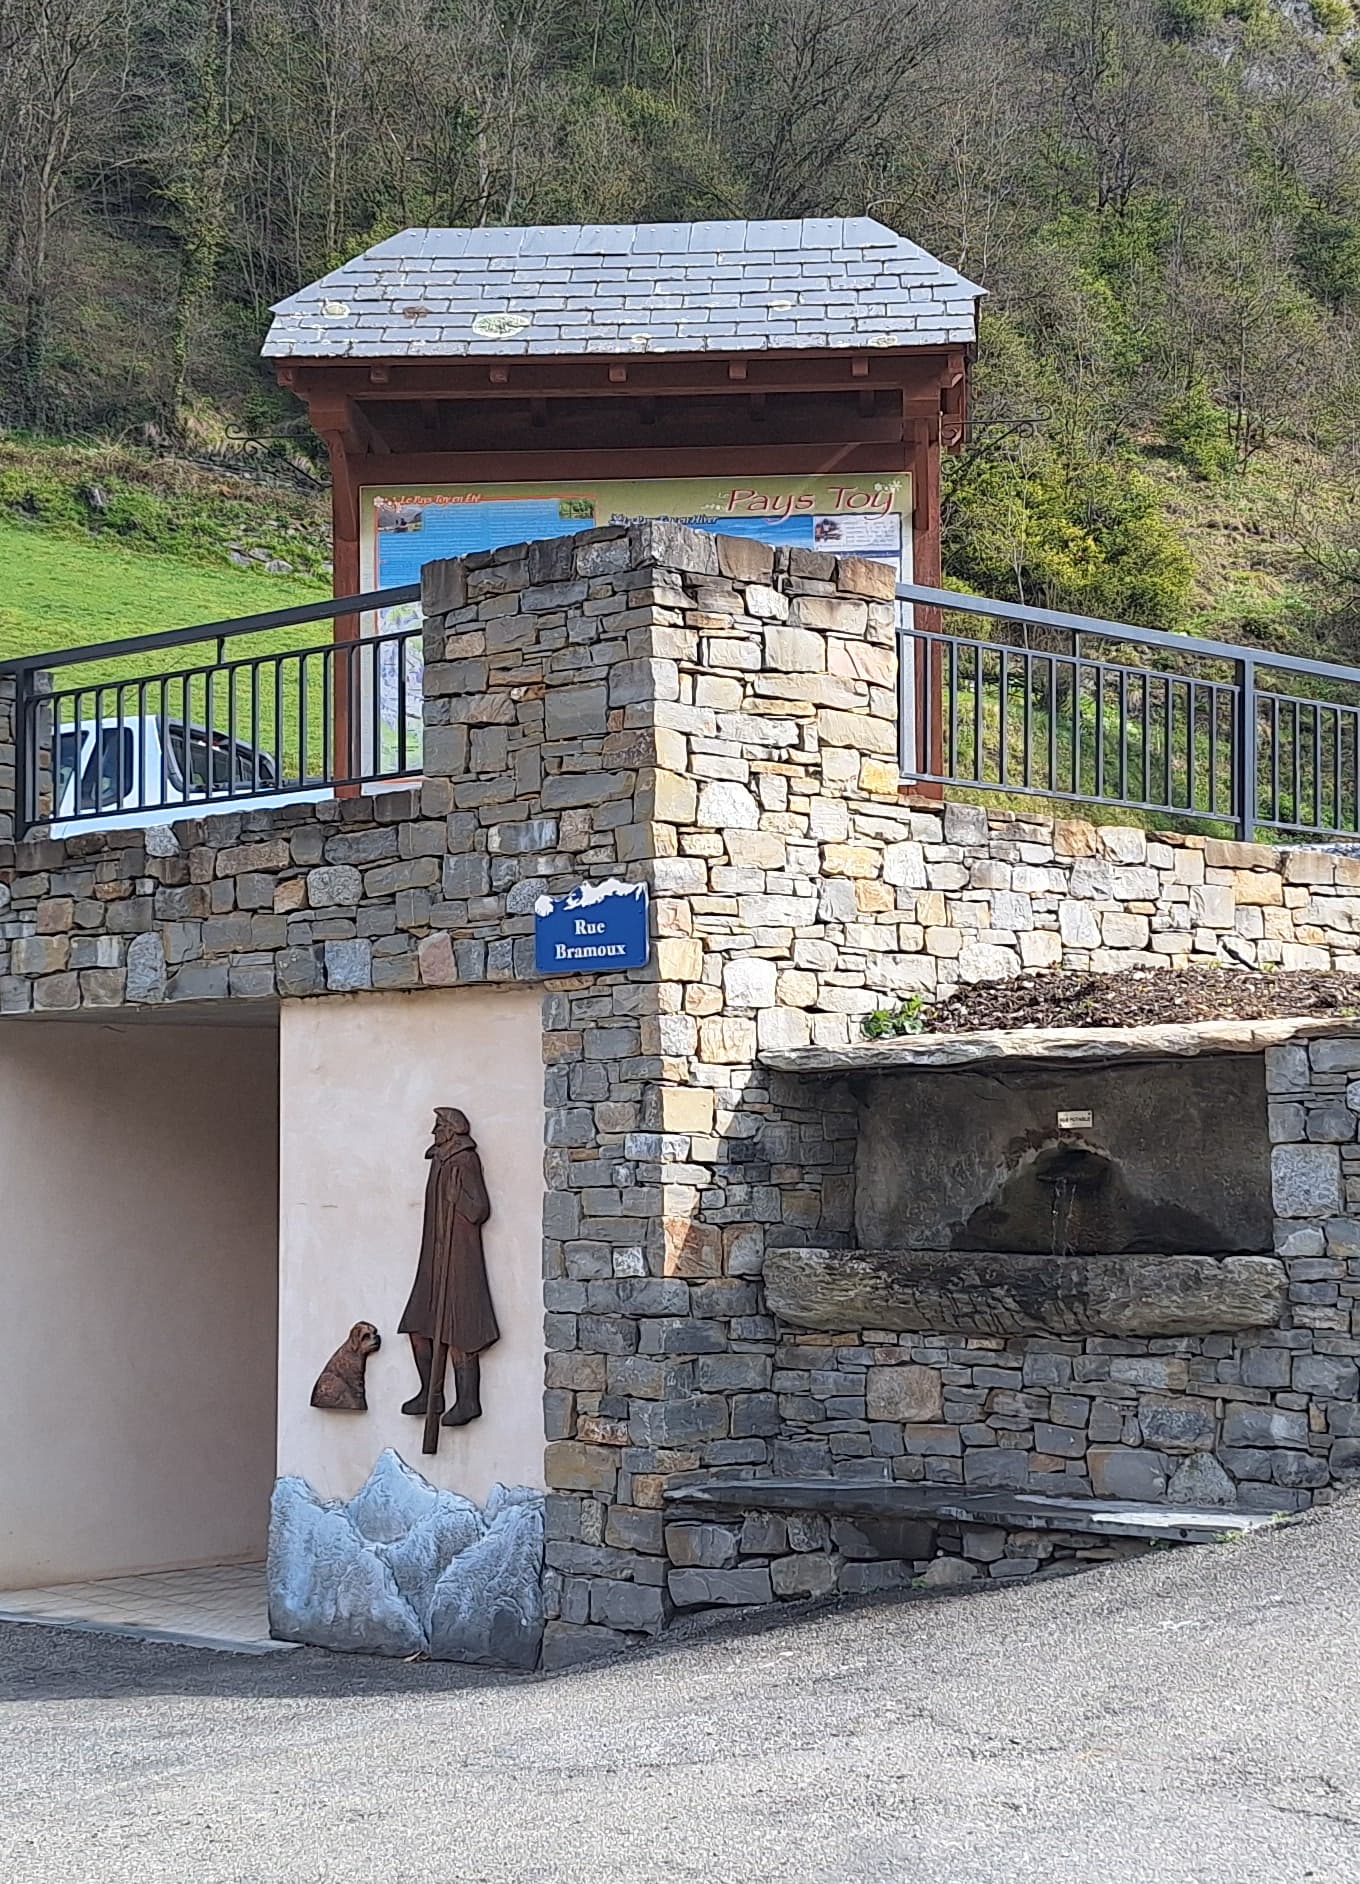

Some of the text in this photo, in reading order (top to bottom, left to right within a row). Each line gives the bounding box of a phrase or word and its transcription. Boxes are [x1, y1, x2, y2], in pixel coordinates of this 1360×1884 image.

[726, 488, 816, 525] Pays
[828, 486, 896, 520] Toy
[574, 919, 606, 935] Rue
[554, 943, 626, 960] Bramoux
